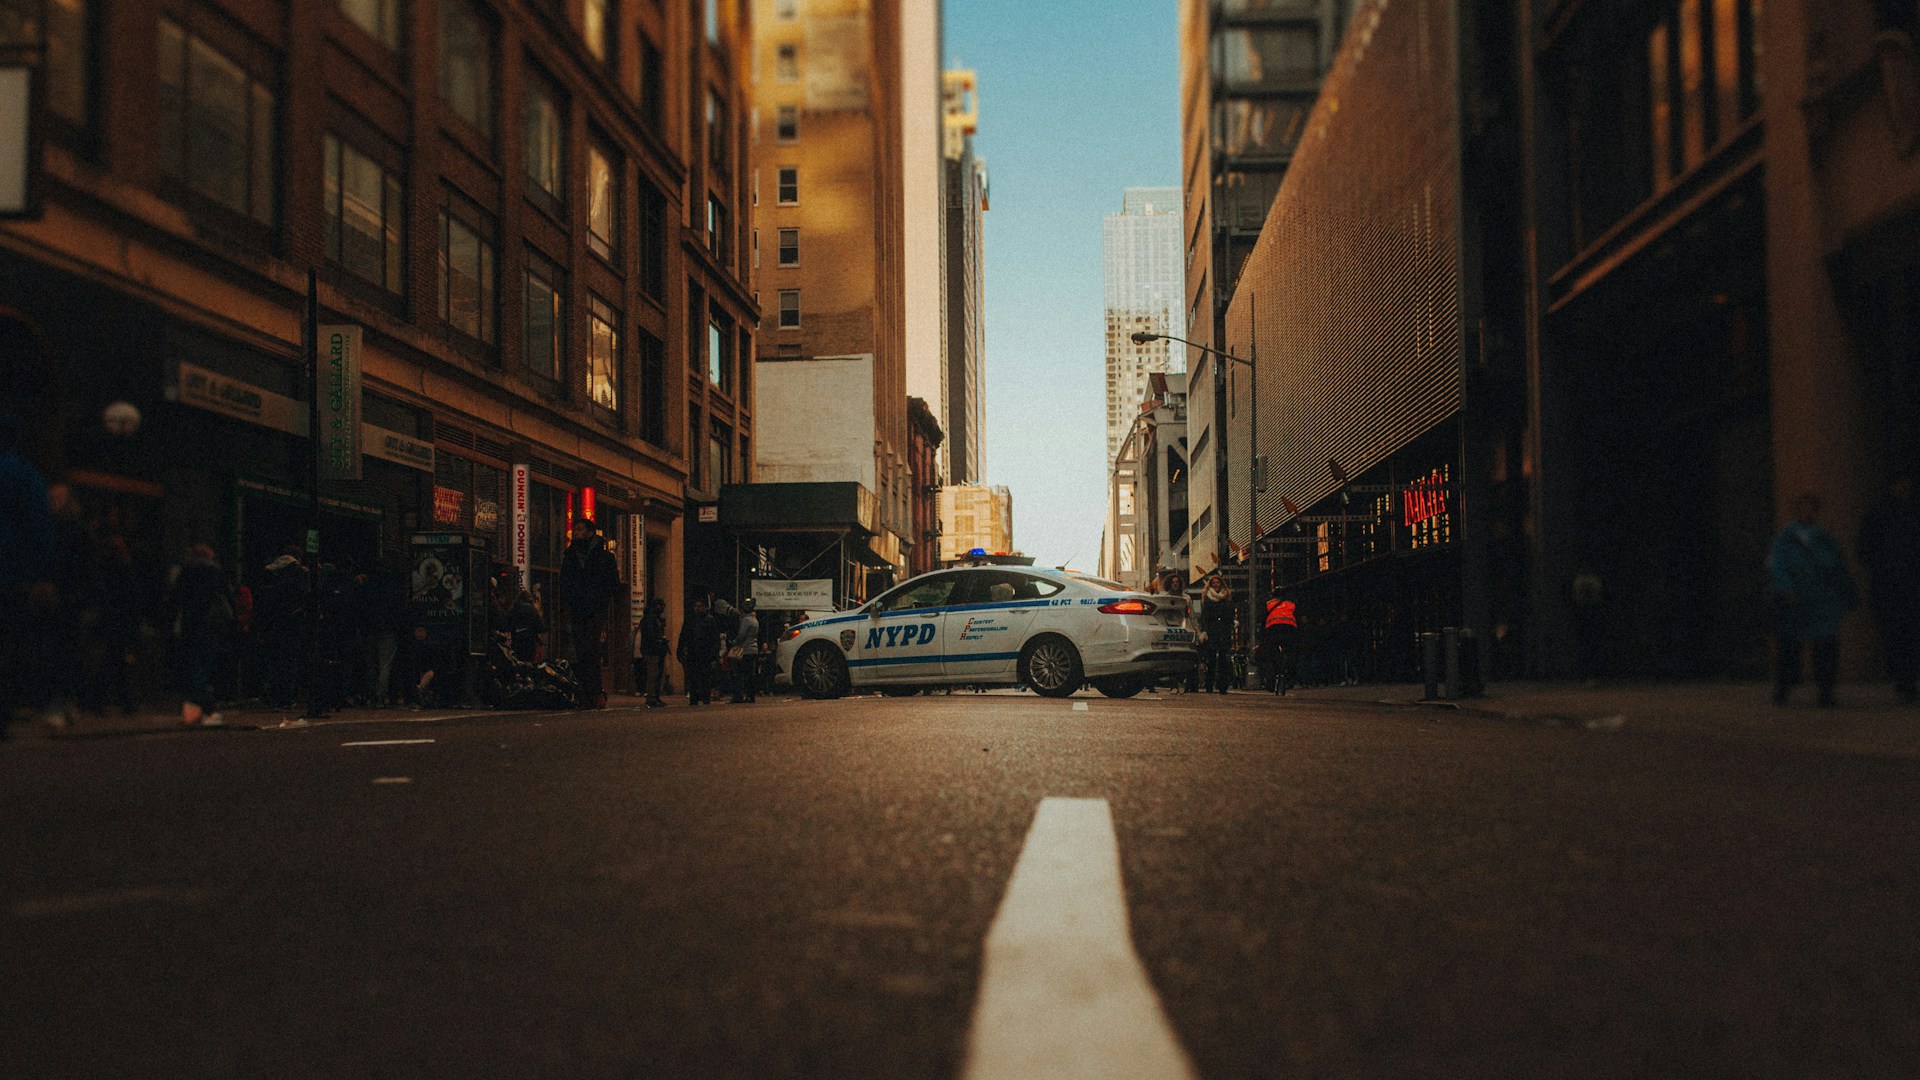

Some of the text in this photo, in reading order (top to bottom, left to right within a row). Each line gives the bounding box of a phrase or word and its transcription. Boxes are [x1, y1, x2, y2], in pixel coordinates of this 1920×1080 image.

[331, 333, 342, 470] GUY & GALLARD
[517, 470, 525, 512] DUNKIN'
[517, 525, 525, 564] DONUTS
[804, 620, 827, 629] POLICE
[864, 623, 936, 650] NYPD
